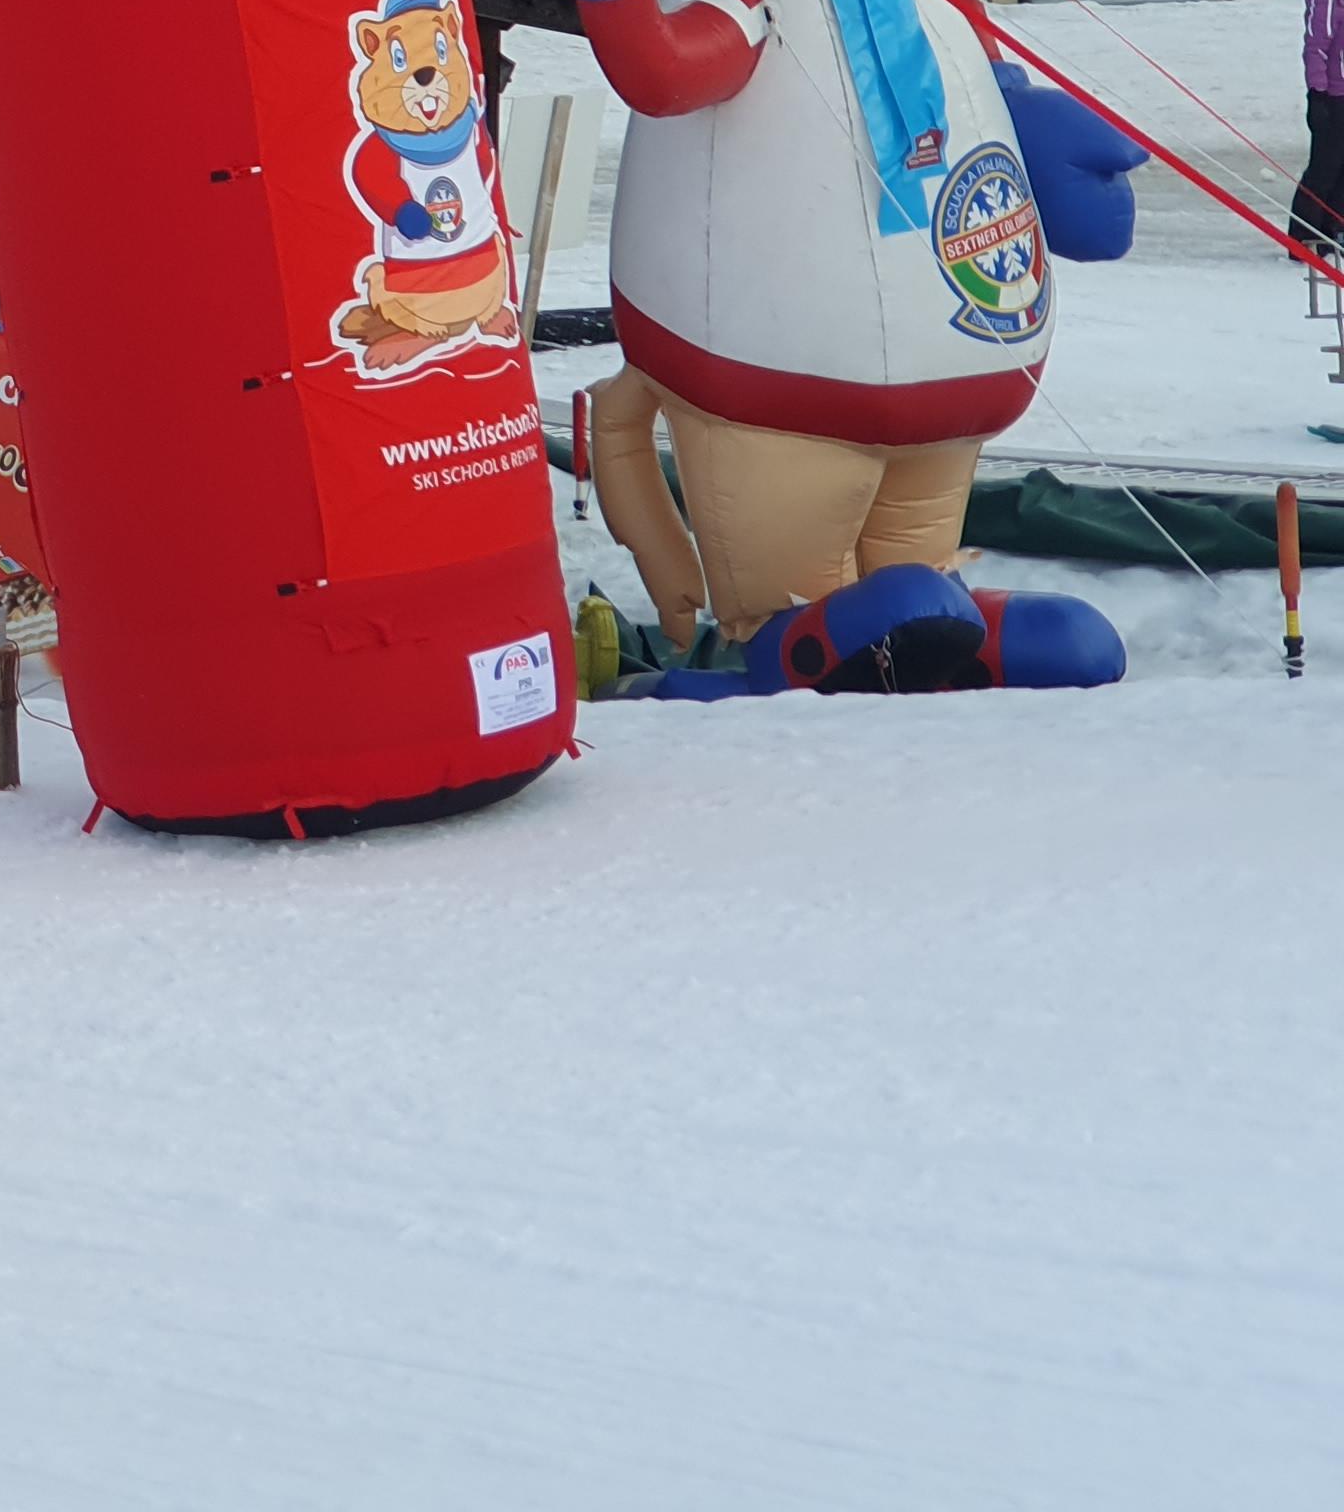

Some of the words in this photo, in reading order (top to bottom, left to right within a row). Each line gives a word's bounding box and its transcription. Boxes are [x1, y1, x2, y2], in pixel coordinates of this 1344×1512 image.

[944, 171, 977, 230] SCUOLA
[945, 228, 999, 259] SEXTNER
[412, 471, 439, 491] SKI
[441, 458, 499, 485] SCHOOL
[506, 653, 529, 672] PAS
